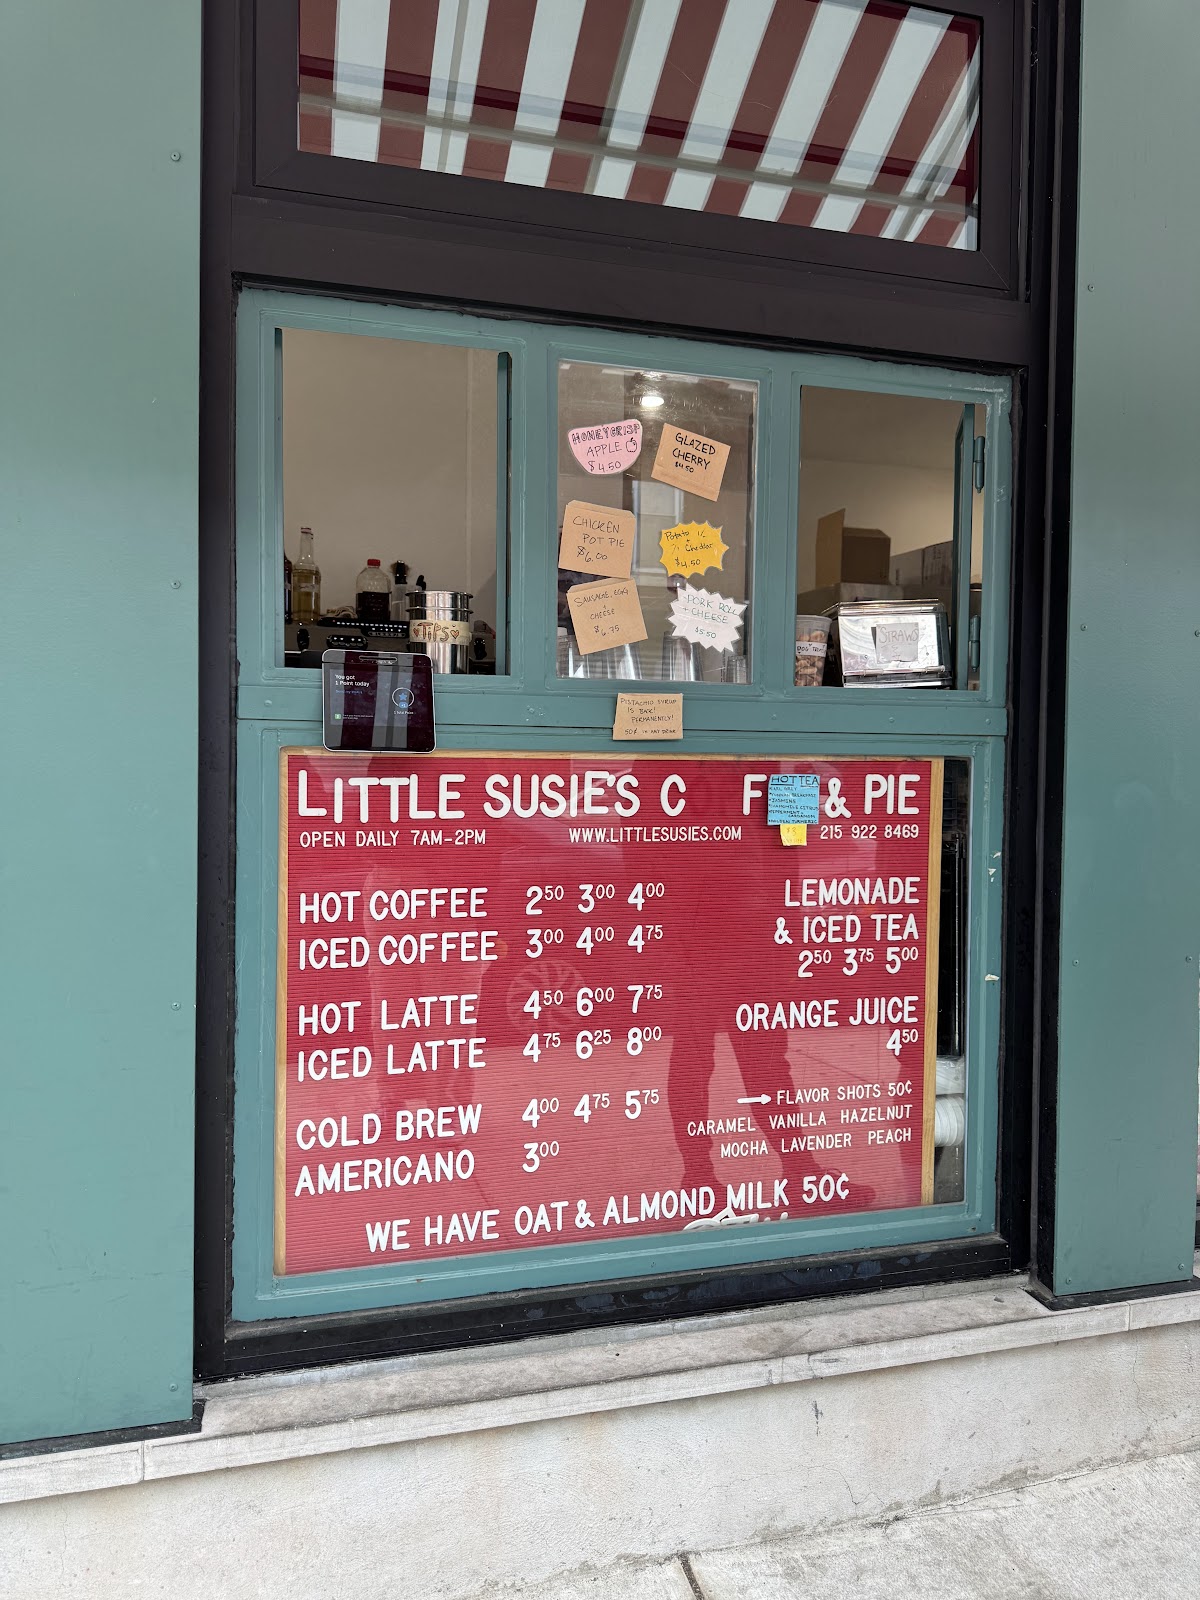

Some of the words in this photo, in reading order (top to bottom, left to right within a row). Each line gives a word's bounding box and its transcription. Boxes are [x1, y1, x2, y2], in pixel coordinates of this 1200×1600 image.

[586, 441, 622, 457] APPLE
[675, 432, 716, 455] GLAZED
[587, 460, 621, 473] $4.50
[672, 447, 711, 470] CHERRY
[572, 515, 620, 534] CHICKEN
[664, 530, 690, 541] Potato
[582, 533, 604, 544] POT
[608, 537, 625, 547] PIE
[577, 545, 608, 563] $6.00
[589, 608, 615, 620] CHEESE
[691, 607, 729, 624] CHEESE
[718, 602, 739, 616] ROLL
[620, 698, 654, 706] PISTACHIO
[799, 776, 820, 785] TEA
[298, 769, 466, 824] LITTLE
[483, 770, 641, 819] SUSIE'S
[825, 777, 852, 819] &
[864, 773, 921, 815] PIE
[299, 830, 346, 848] OPEN
[355, 830, 399, 847] DAILY
[410, 829, 486, 846] 7AM-2PM
[569, 826, 741, 844] WWW.LITTLESUSIES.COM
[819, 824, 843, 840] 215
[851, 824, 878, 840] 922
[884, 824, 919, 839] 8469
[784, 876, 921, 907] LEMONADE
[299, 890, 362, 924] HOT
[368, 887, 488, 921] COFFEE
[773, 916, 793, 945] &
[803, 914, 862, 944] ICED
[870, 913, 919, 941] TEA
[299, 936, 371, 971] ICED
[378, 930, 499, 966] COFFEE
[298, 1000, 362, 1037] HOT
[380, 993, 479, 1031] LATTE
[735, 999, 840, 1032] ORANGE
[848, 995, 919, 1026] JUICE
[297, 1045, 373, 1083] ICED
[386, 1037, 487, 1075] LATTE
[776, 1086, 830, 1105] FLAVOR
[836, 1083, 882, 1101] SHOTS
[887, 1079, 913, 1097] 50¢
[295, 1112, 382, 1151] COLD
[395, 1103, 483, 1142] BREW
[687, 1116, 757, 1137] CARAMEL
[768, 1110, 827, 1130] VANILLA
[840, 1104, 913, 1125] HAZELNUT
[720, 1139, 769, 1159] MOCHA
[781, 1132, 852, 1153] LAVENDER
[867, 1127, 912, 1146] PEACH
[294, 1148, 475, 1198] AMERICANO
[365, 1218, 411, 1253] WE
[424, 1208, 501, 1247] HAVE
[514, 1200, 570, 1236] OAT
[574, 1198, 596, 1229] &
[602, 1185, 716, 1226] ALMOND
[727, 1178, 789, 1211] MILK
[801, 1172, 850, 1204] 50¢
